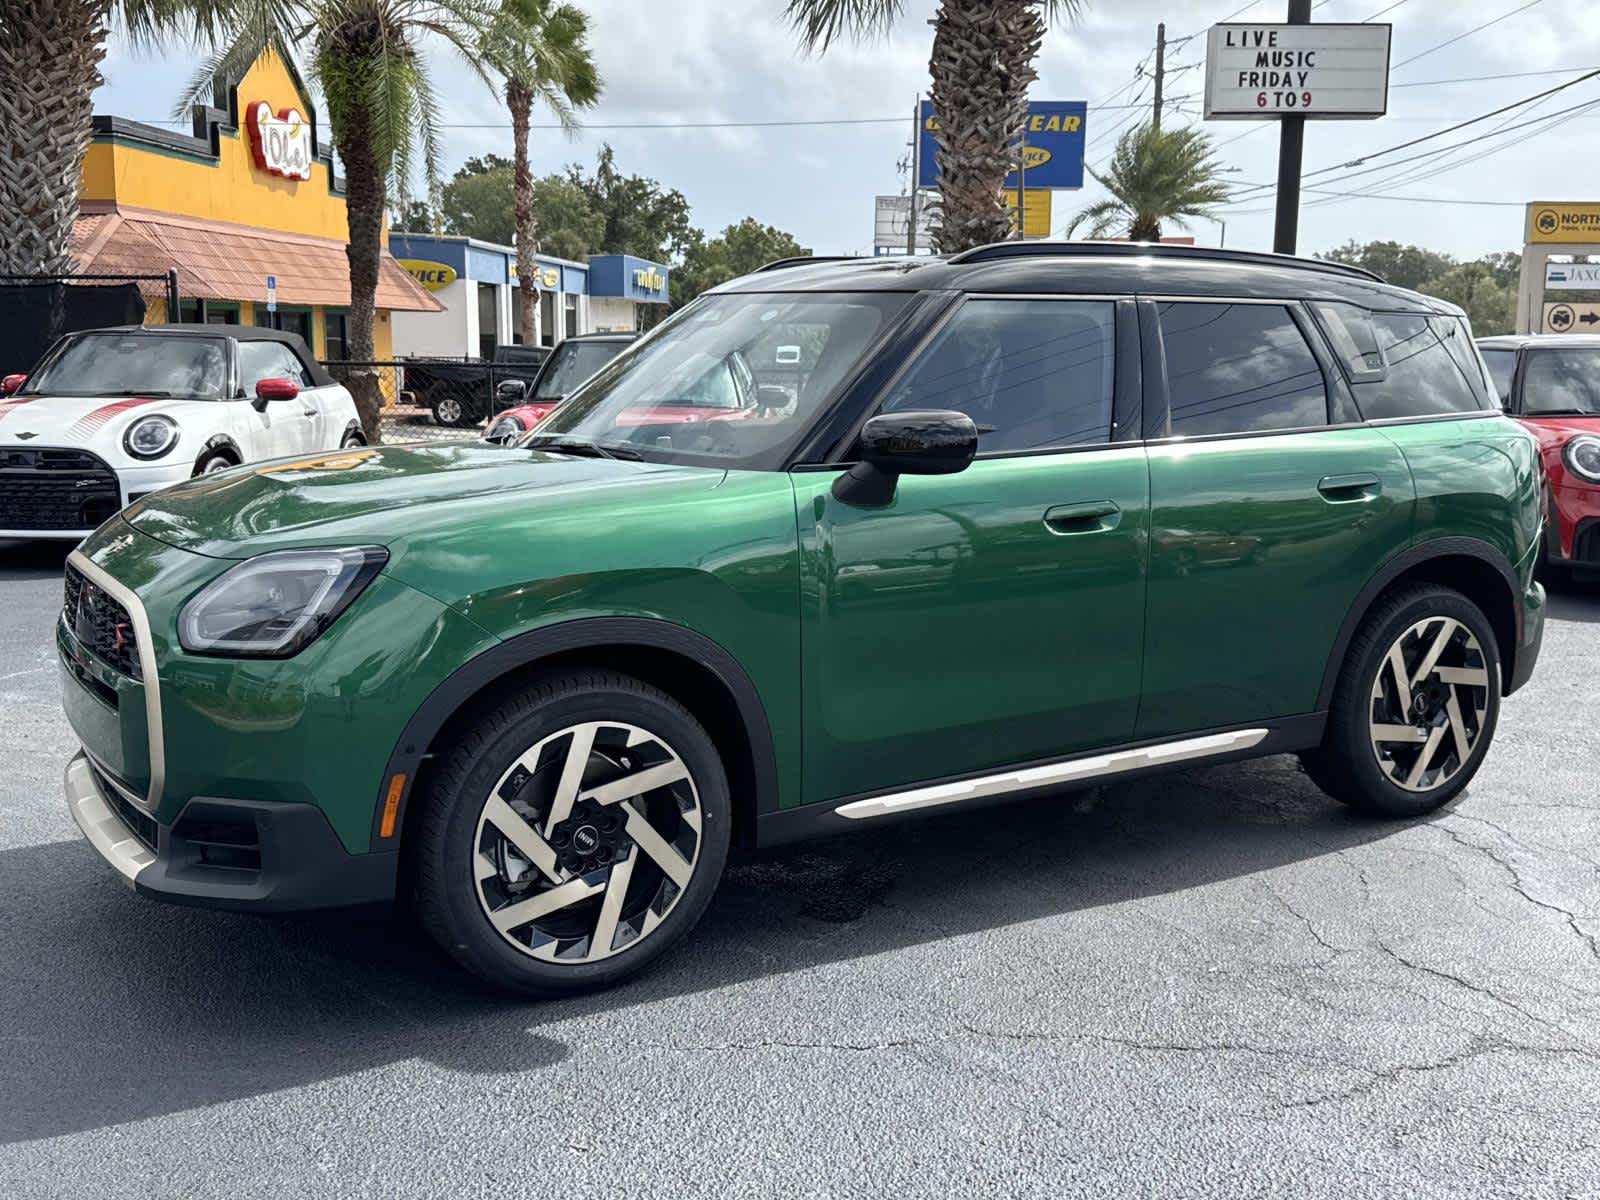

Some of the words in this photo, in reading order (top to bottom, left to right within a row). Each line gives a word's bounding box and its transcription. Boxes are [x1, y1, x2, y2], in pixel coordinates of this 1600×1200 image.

[1226, 31, 1278, 47] LIVE
[1255, 51, 1316, 68] MUSIC
[1238, 71, 1309, 88] FRIDAY
[1256, 92, 1267, 107] 6
[1301, 92, 1312, 108] 9
